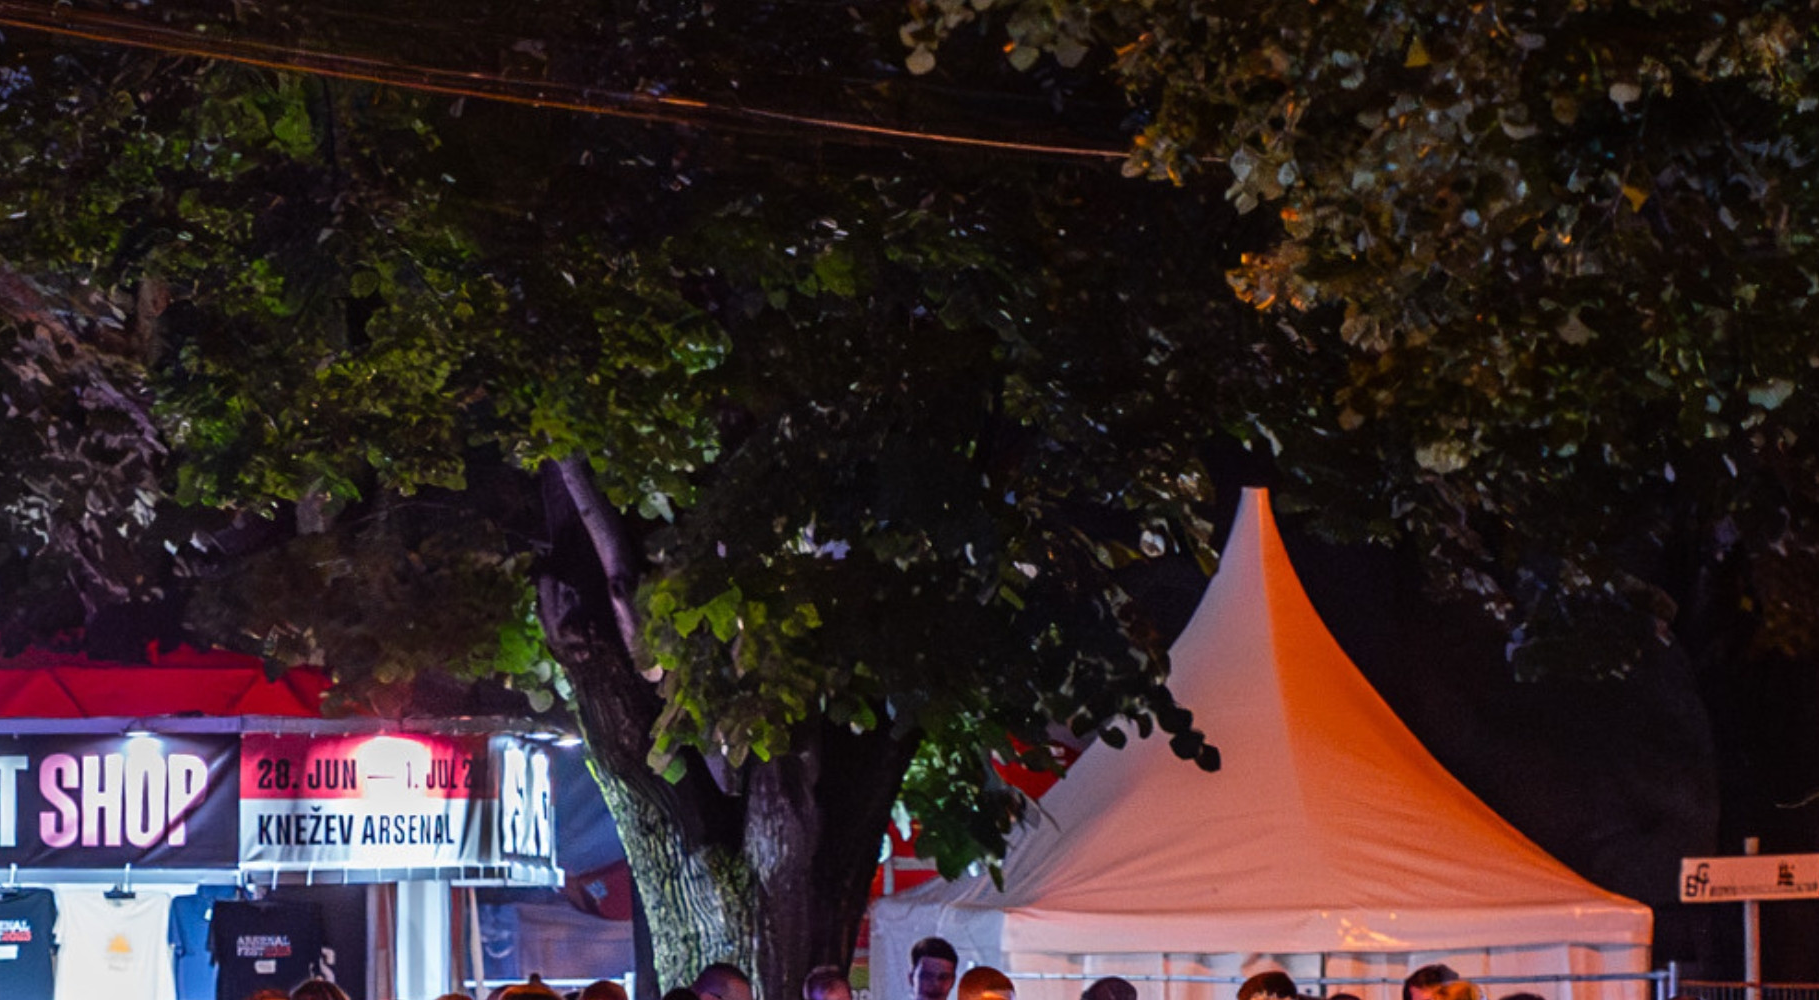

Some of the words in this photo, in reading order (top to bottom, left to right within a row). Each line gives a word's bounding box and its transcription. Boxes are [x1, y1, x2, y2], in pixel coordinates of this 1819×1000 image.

[307, 758, 358, 790] JUN
[426, 757, 458, 790] JUL
[39, 752, 209, 849] SHOP
[258, 805, 355, 846] KNEŽEV
[361, 814, 456, 846] ARSENAL
